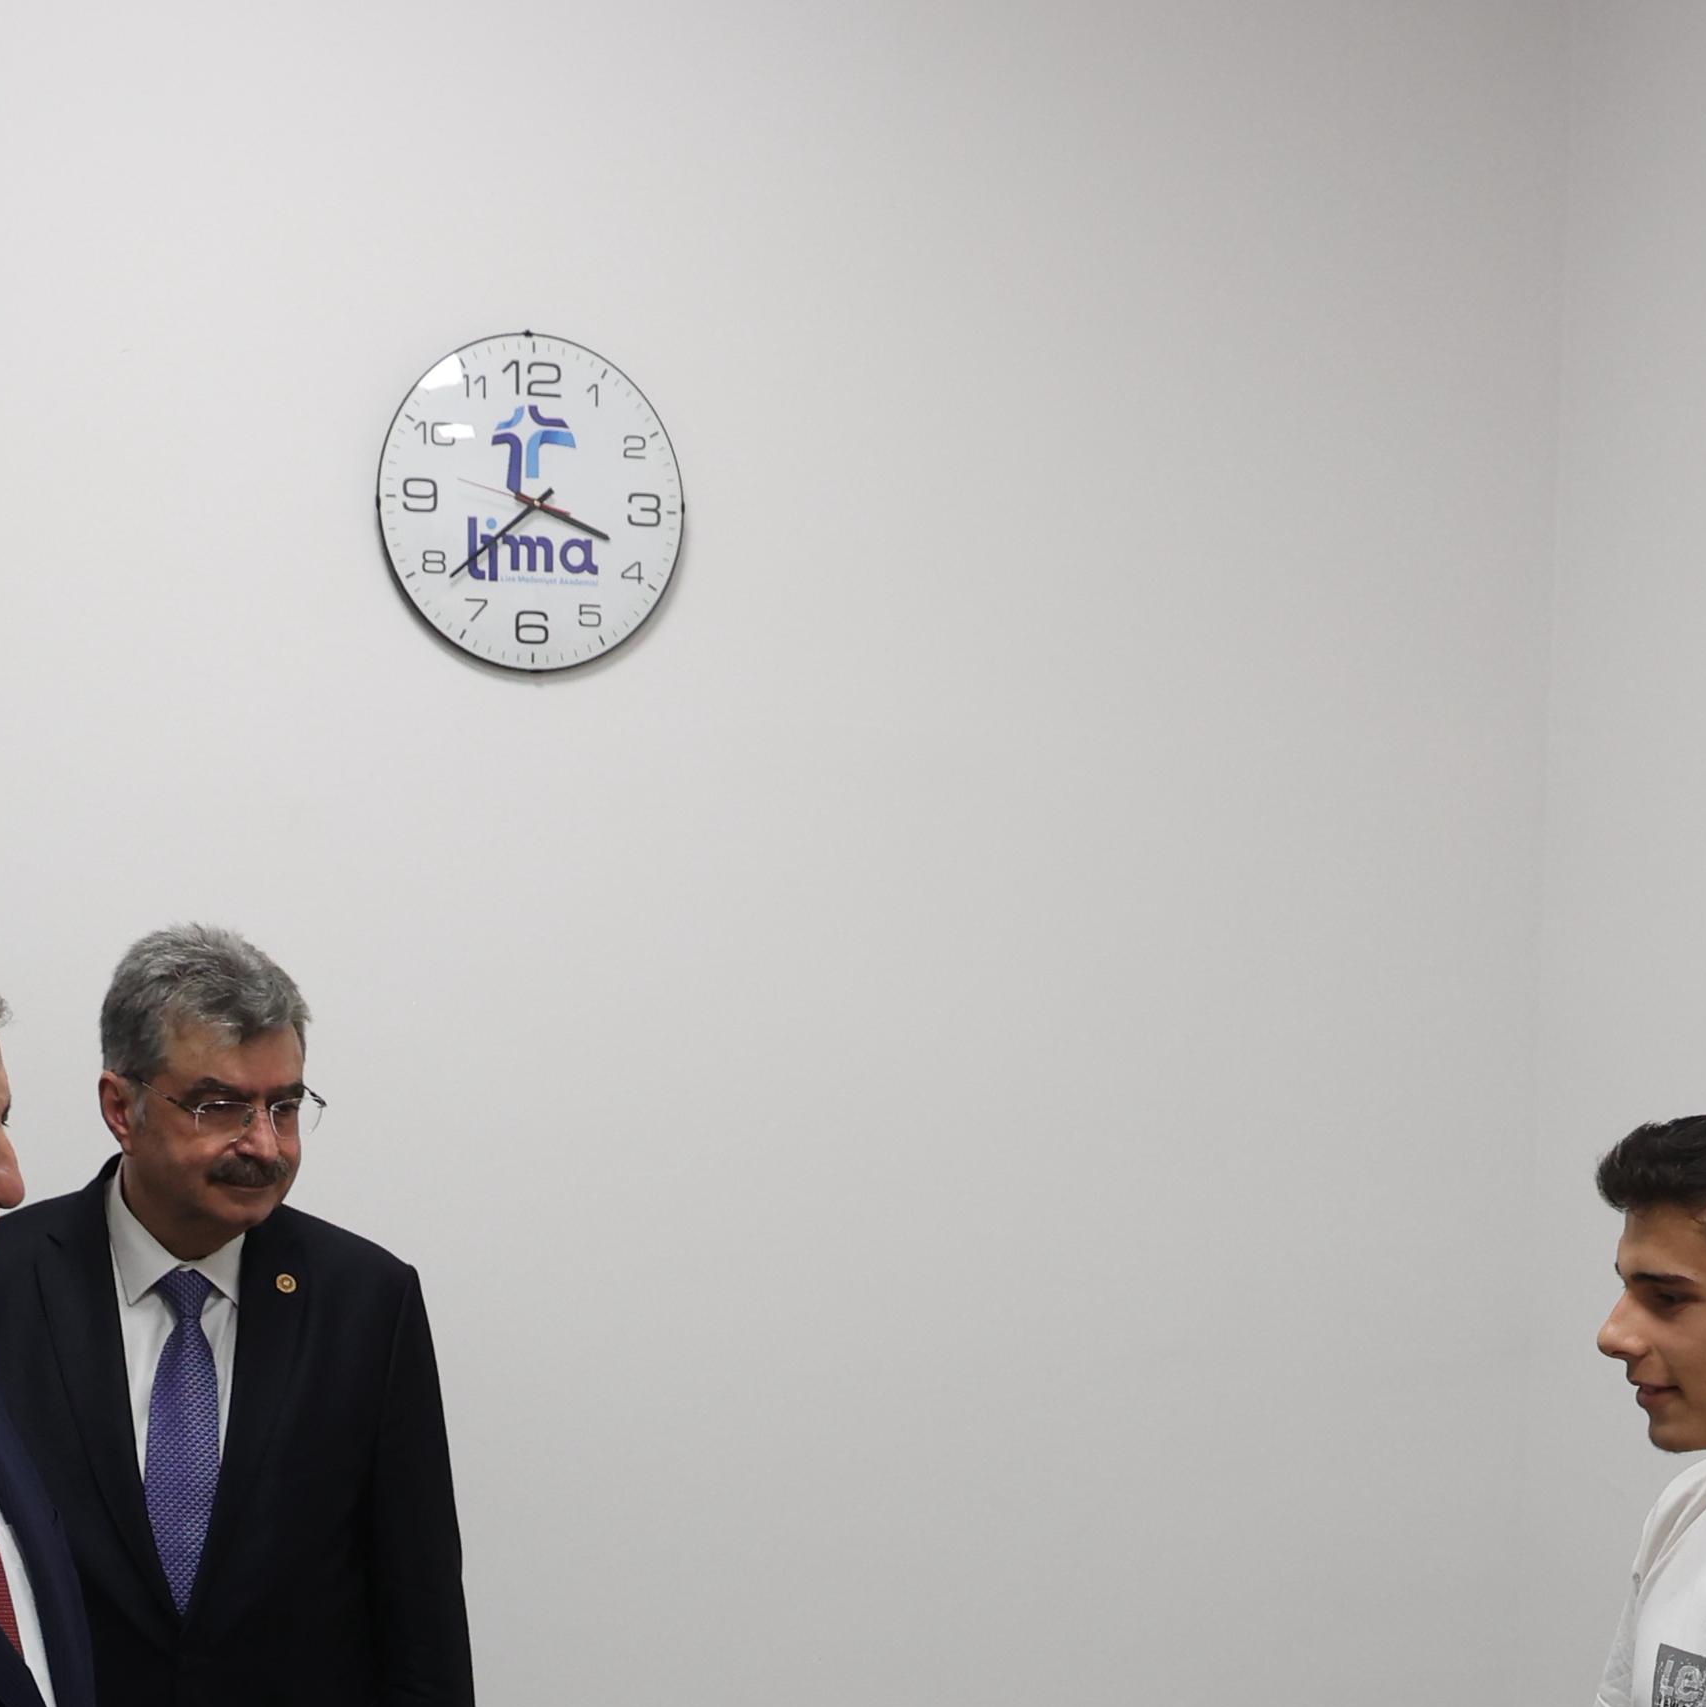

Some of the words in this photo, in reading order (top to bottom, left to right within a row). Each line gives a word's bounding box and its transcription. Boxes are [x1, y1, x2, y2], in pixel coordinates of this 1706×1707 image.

[463, 374, 488, 399] 11
[502, 359, 562, 398] 12
[586, 383, 599, 407] 1
[623, 435, 646, 459] 2
[402, 477, 437, 512] 9
[627, 493, 661, 527] 3
[468, 516, 599, 582] lima
[422, 550, 446, 574] 8
[621, 561, 644, 584] 4
[464, 598, 488, 622] 7
[578, 603, 602, 627] 5
[515, 610, 549, 644] 6
